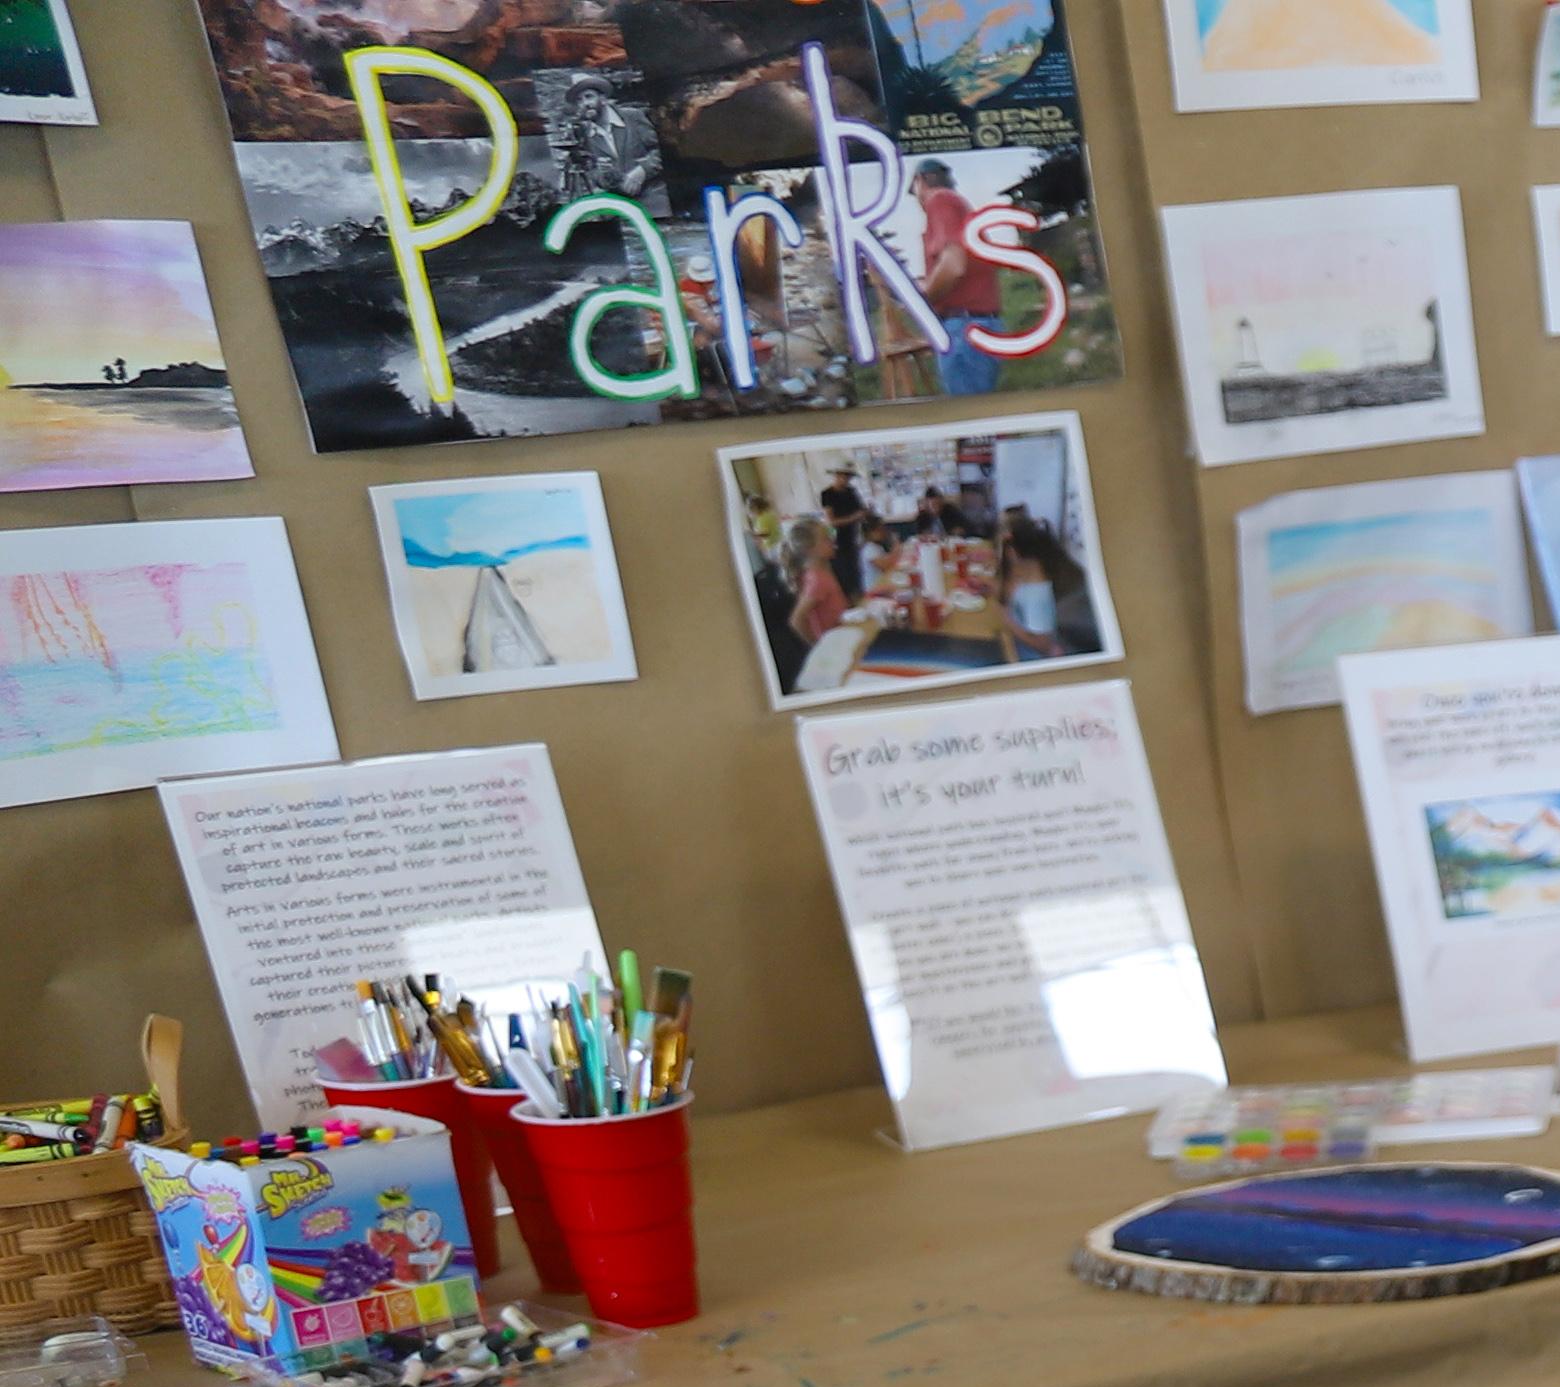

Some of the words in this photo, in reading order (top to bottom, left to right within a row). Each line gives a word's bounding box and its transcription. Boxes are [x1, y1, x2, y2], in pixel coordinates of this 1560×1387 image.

[906, 112, 962, 128] BIG
[976, 105, 1064, 124] BEND
[344, 42, 1069, 404] Parks
[827, 739, 901, 776] Grab
[912, 733, 984, 761] some
[195, 811, 221, 823] Our
[227, 803, 284, 819] nation's
[287, 796, 342, 812] national
[347, 791, 386, 806] parks
[391, 789, 425, 800] have
[430, 785, 457, 798] long
[460, 777, 505, 793] served
[942, 777, 1000, 804] your
[1013, 761, 1085, 790] turn!
[202, 820, 291, 839] inspirational
[295, 816, 348, 829] beacons
[354, 811, 377, 823] and
[222, 843, 236, 856] of
[242, 842, 265, 853] art
[288, 836, 338, 848] various
[392, 823, 433, 834] These
[439, 819, 479, 830] works
[482, 814, 519, 825] often
[222, 873, 291, 893] protected
[296, 867, 369, 883] landscapes
[374, 862, 397, 874] and
[403, 858, 436, 869] their
[442, 851, 484, 865] sacred
[225, 859, 281, 874] capture
[288, 855, 312, 866] the
[317, 851, 343, 862] raw
[404, 840, 437, 852] scale
[442, 835, 465, 847] and
[261, 1172, 335, 1220] SKETCH
